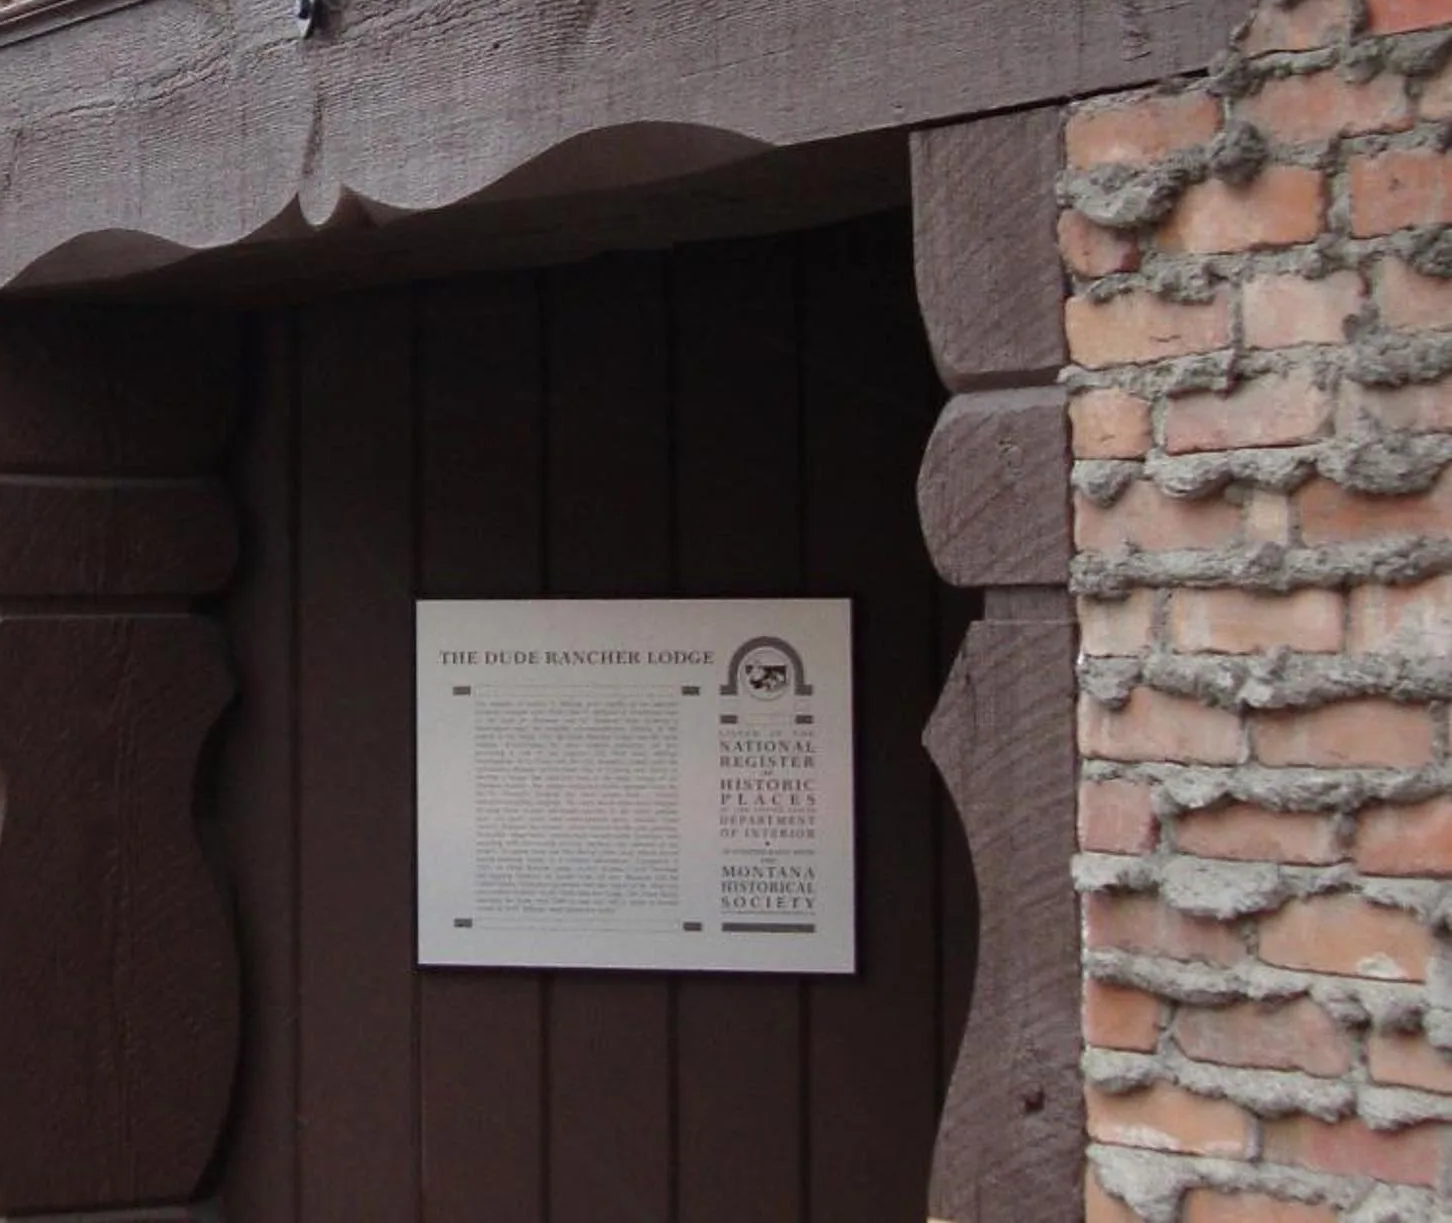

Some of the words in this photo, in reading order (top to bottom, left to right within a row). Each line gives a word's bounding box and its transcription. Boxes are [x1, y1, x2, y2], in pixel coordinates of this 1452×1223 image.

[440, 651, 477, 665] THE
[484, 651, 540, 665] DUDE
[545, 651, 641, 665] RANCHER
[647, 651, 714, 665] LODGE
[719, 740, 816, 753] NATIONAL
[719, 756, 815, 769] REGISTER
[720, 778, 817, 792] HISTORIC
[720, 793, 817, 806] PLACES
[719, 814, 816, 826] DEPARTMENT
[719, 828, 737, 839] OF
[721, 865, 816, 879] MONTANA
[721, 881, 816, 894] HISTORICAL
[721, 896, 816, 909] SOCIETY
